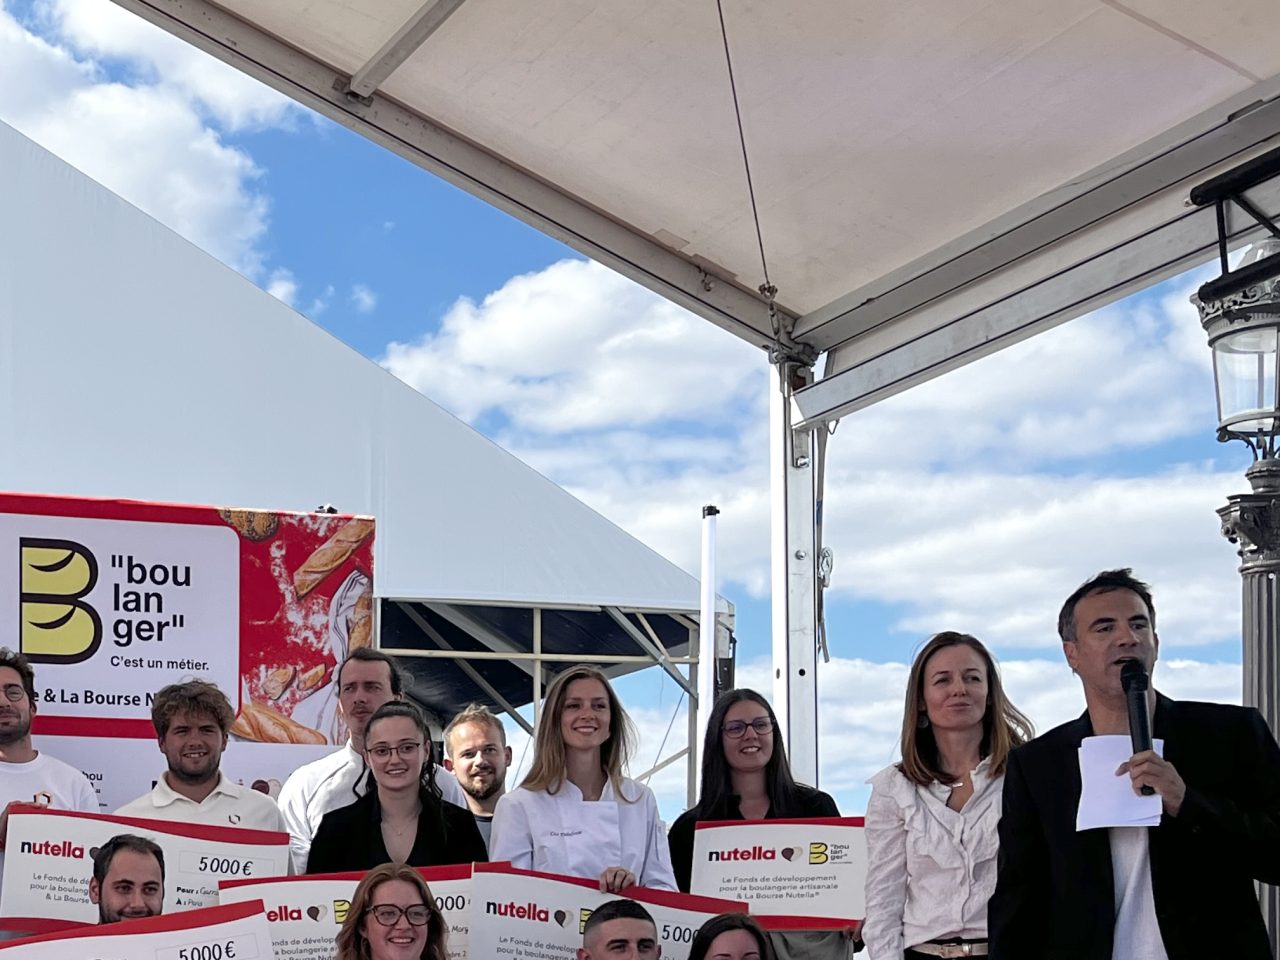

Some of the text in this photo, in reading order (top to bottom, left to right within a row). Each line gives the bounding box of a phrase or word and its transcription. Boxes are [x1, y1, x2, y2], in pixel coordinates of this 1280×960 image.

[113, 583, 163, 613] lan
[110, 655, 209, 671] C'est un métier.
[44, 689, 56, 703] &
[61, 689, 78, 703] La
[84, 690, 141, 706] Bourse
